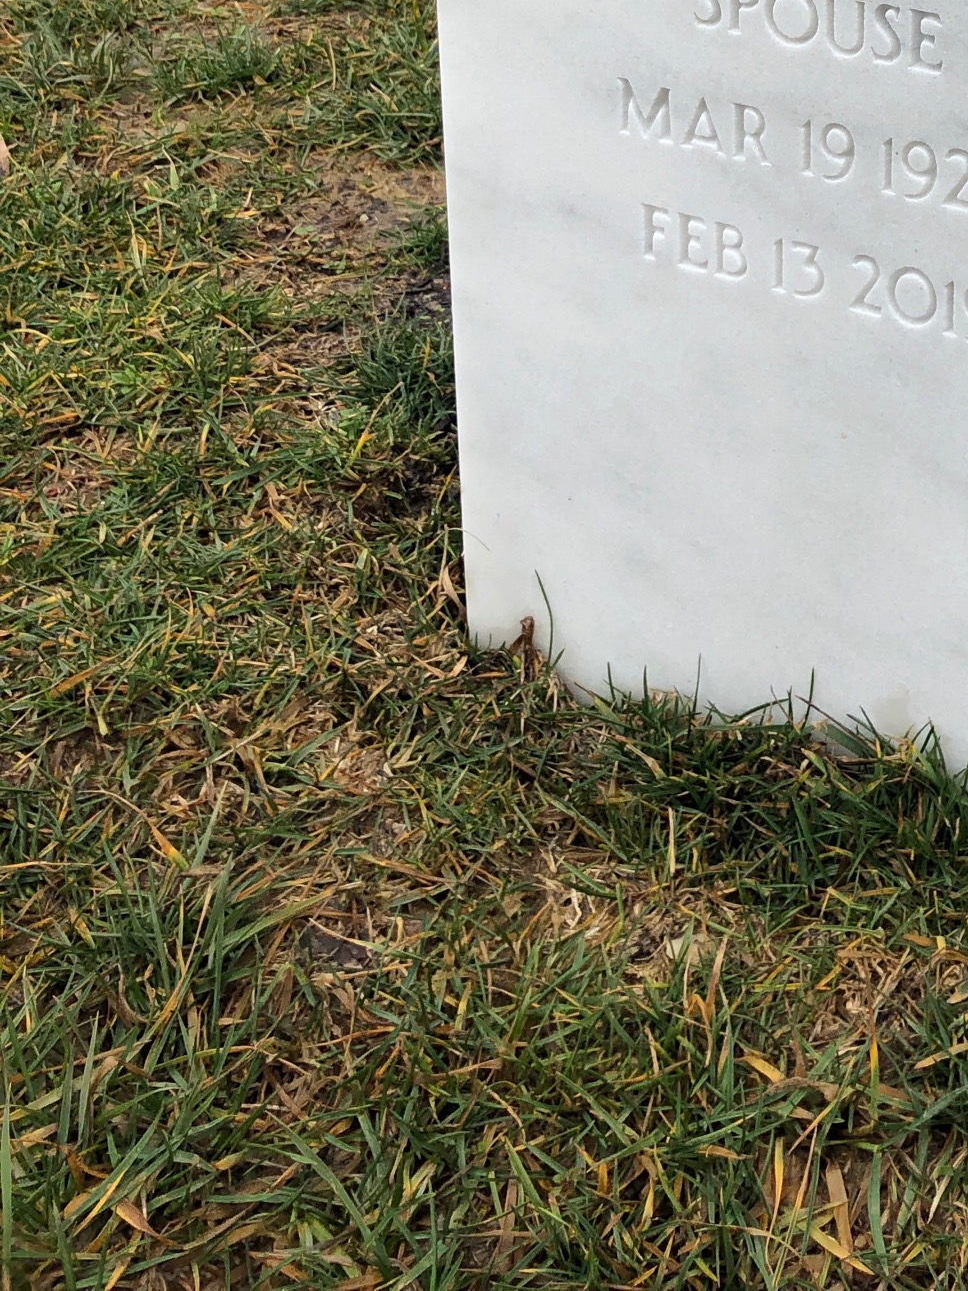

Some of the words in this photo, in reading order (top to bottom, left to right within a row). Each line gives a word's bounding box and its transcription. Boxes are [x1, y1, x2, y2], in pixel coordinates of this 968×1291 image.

[616, 77, 772, 167] MAR
[799, 119, 857, 182] 19
[641, 203, 749, 280] FEB
[772, 238, 826, 298] 13
